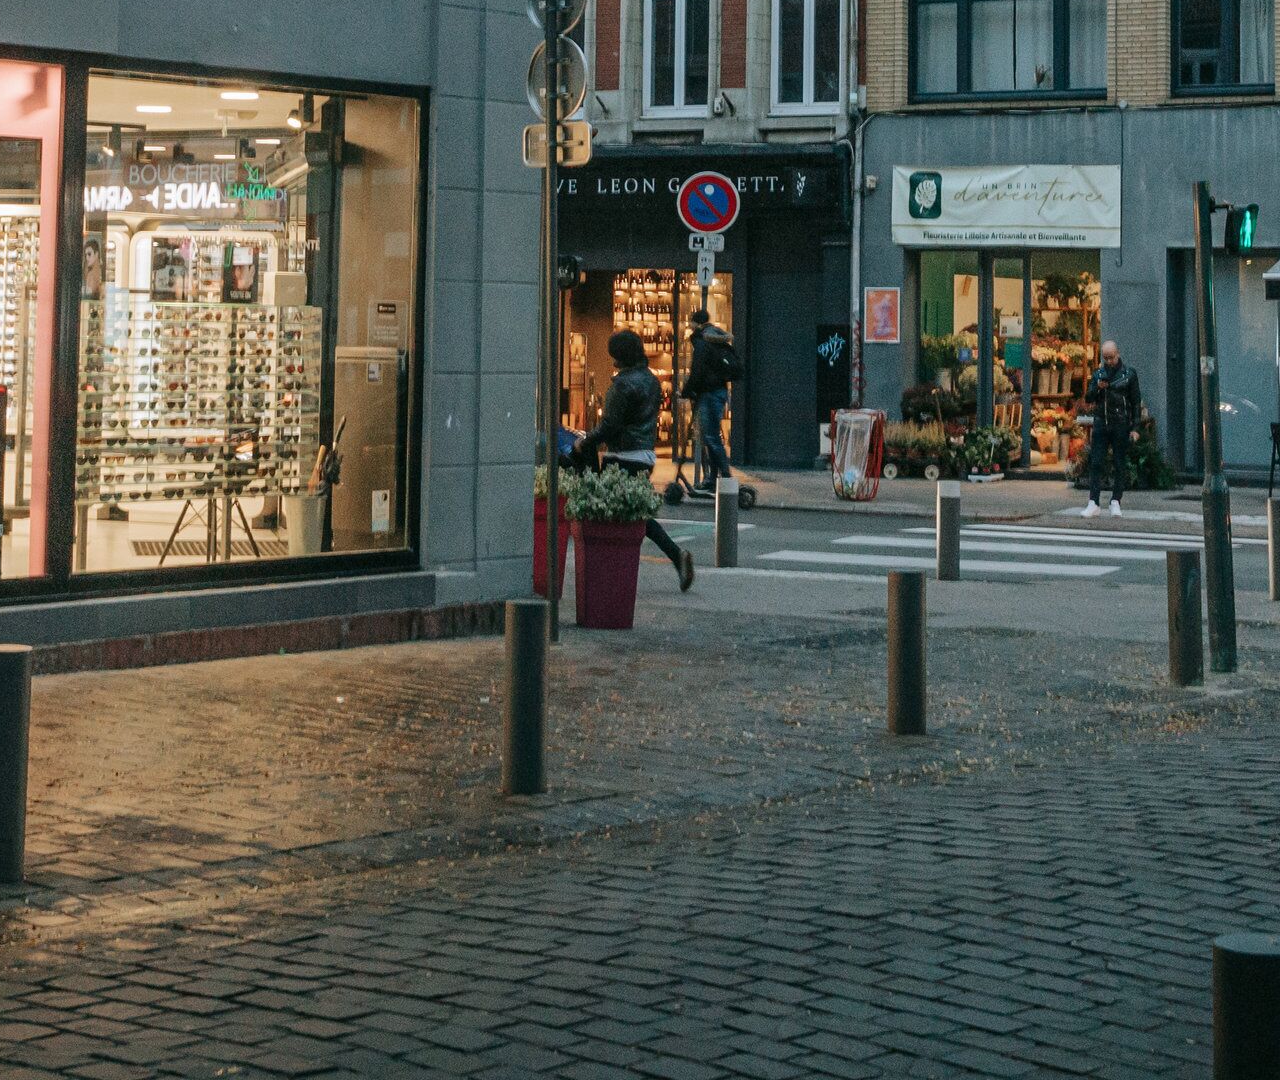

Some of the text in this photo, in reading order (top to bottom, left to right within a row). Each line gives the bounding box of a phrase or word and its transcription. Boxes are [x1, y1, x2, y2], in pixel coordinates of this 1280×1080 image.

[129, 163, 237, 184] BOUCHERIE
[596, 178, 656, 194] LEON
[1007, 182, 1038, 190] BRIN
[923, 231, 1087, 241] Fleuristerie Lilloise Artisanale et Bienveillante
